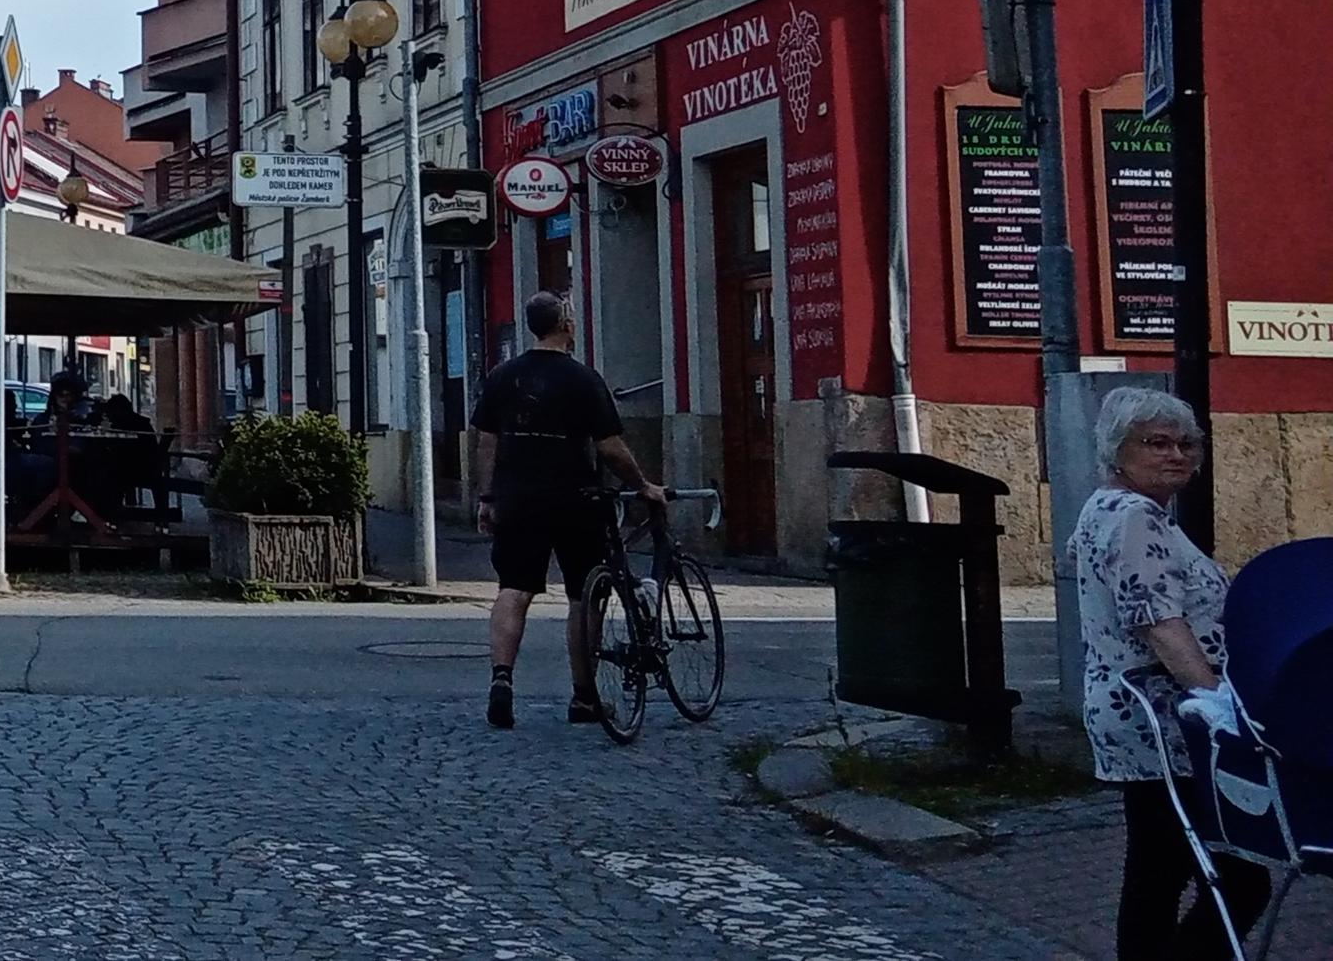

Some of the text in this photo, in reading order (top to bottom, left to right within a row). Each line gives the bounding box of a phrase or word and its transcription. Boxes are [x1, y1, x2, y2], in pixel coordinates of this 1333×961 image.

[685, 14, 771, 71] VINÁRNA
[682, 56, 779, 122] VINOTÉKA
[981, 114, 1024, 134] Jaku
[1129, 119, 1173, 137] Jaku
[988, 135, 1022, 145] DRU
[601, 146, 651, 160] VINNÝ
[961, 145, 1024, 156] SUDOVÝCH
[272, 156, 329, 166] TENTO PROSTOR
[262, 168, 270, 177] JE
[271, 168, 286, 177] POD
[603, 161, 650, 173] SKLEP
[268, 180, 334, 191] DOHLEDEM KAMER
[507, 182, 565, 193] MANUEL
[1006, 282, 1040, 291] MORAVS
